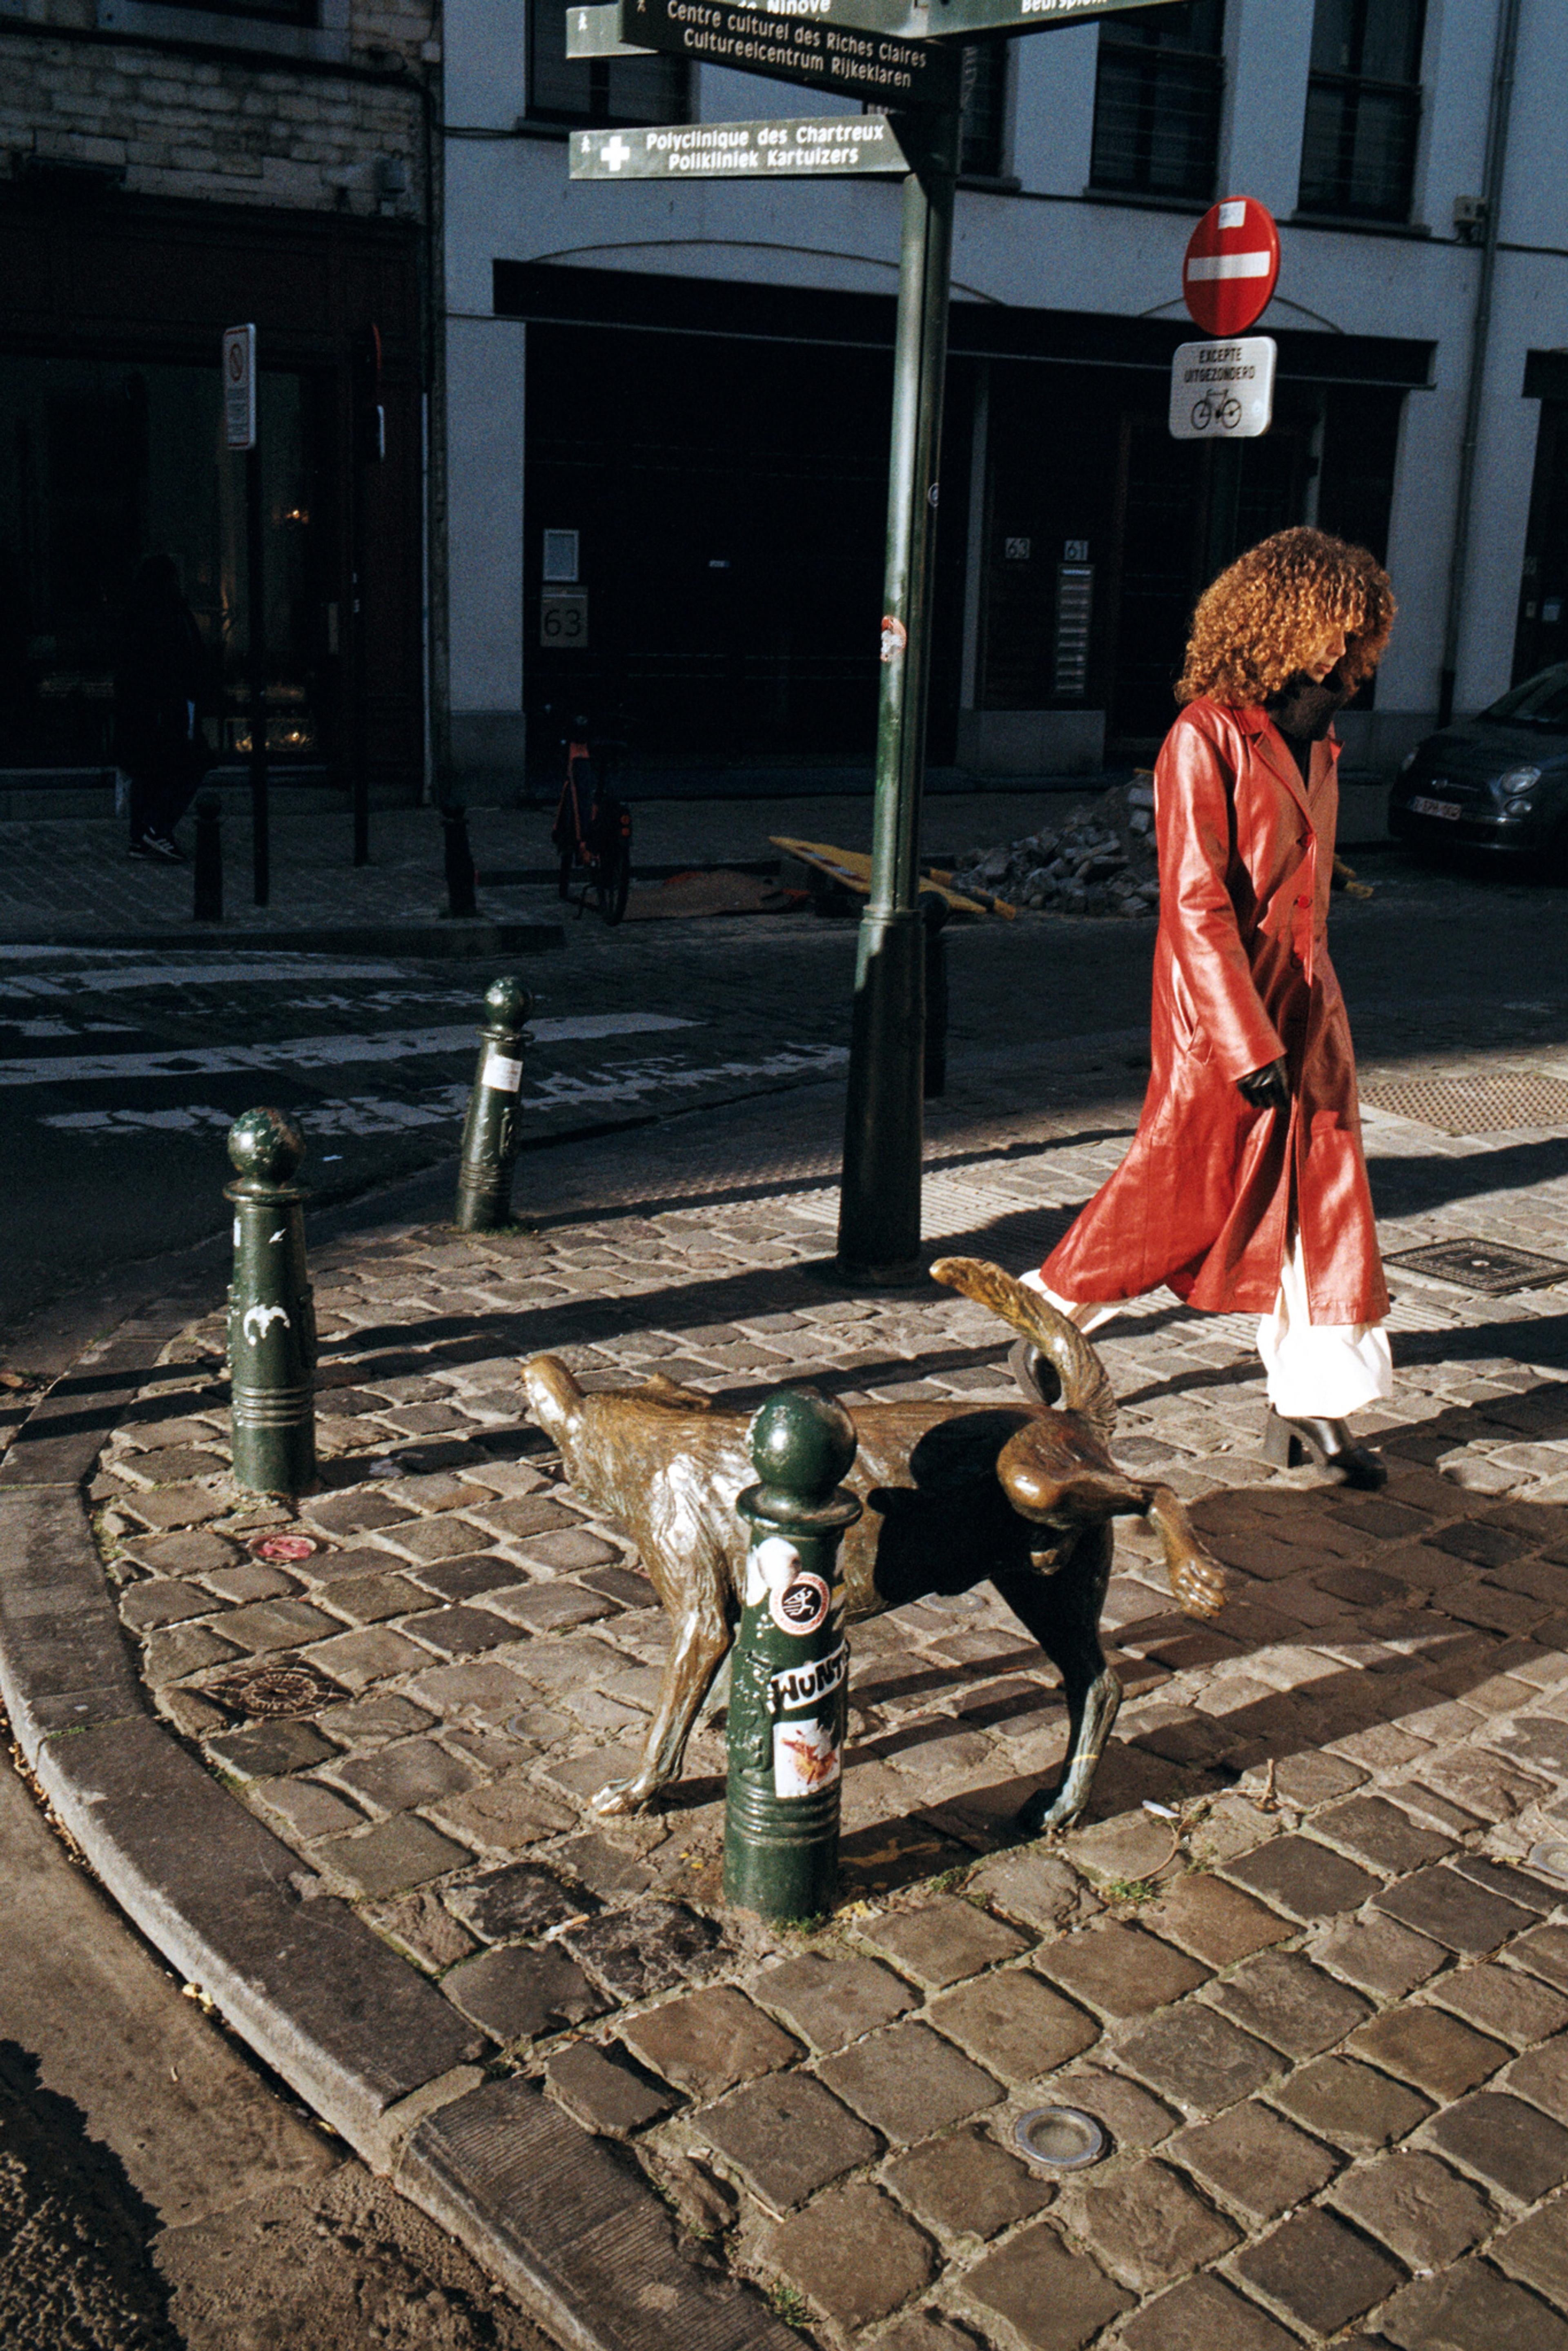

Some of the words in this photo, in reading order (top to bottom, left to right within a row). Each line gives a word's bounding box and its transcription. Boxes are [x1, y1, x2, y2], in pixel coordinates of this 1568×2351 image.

[667, 0, 722, 28] Centre
[727, 15, 789, 41] culturel
[794, 26, 820, 47] des
[826, 32, 874, 57] Riches
[879, 43, 927, 67] Claires
[684, 28, 824, 71] Cultureelcentrum
[831, 56, 911, 88] Rijkeklaren
[646, 131, 749, 151] Polyclinique
[757, 128, 787, 145] des
[796, 125, 884, 143] Chartreux
[668, 150, 759, 171] Polikliniek
[767, 147, 858, 167] Kartuizers
[1199, 347, 1242, 363] EXCEPTE
[1185, 366, 1255, 383] UITGEZONDERD
[1007, 538, 1027, 558] 63
[1067, 540, 1085, 559] 61
[545, 609, 581, 637] 63
